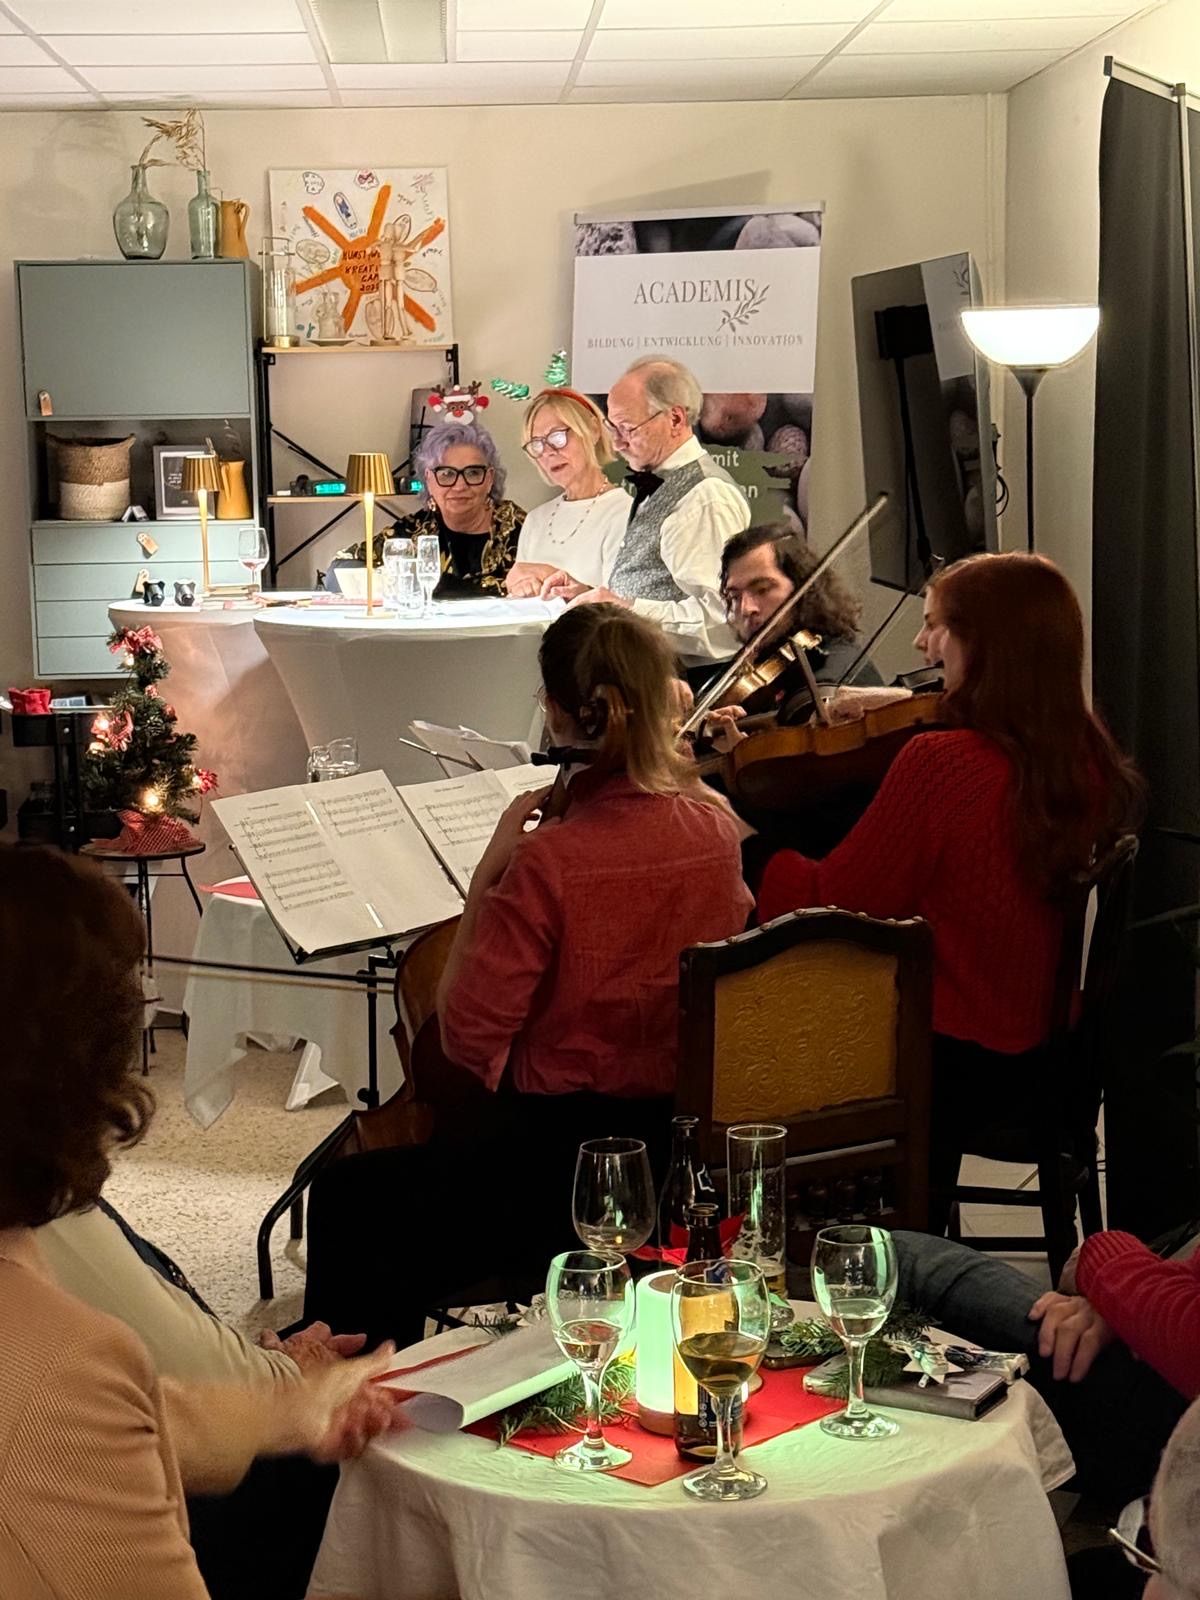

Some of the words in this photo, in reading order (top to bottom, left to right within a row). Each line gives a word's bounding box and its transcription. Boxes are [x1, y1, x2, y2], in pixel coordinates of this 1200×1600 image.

[345, 263, 378, 274] KREATI
[361, 273, 379, 282] CAM
[633, 278, 757, 304] ACADEMIS
[587, 336, 634, 349] BILDUNG
[644, 335, 721, 347] ENTWICKLUNG
[733, 334, 803, 347] INNOVATION
